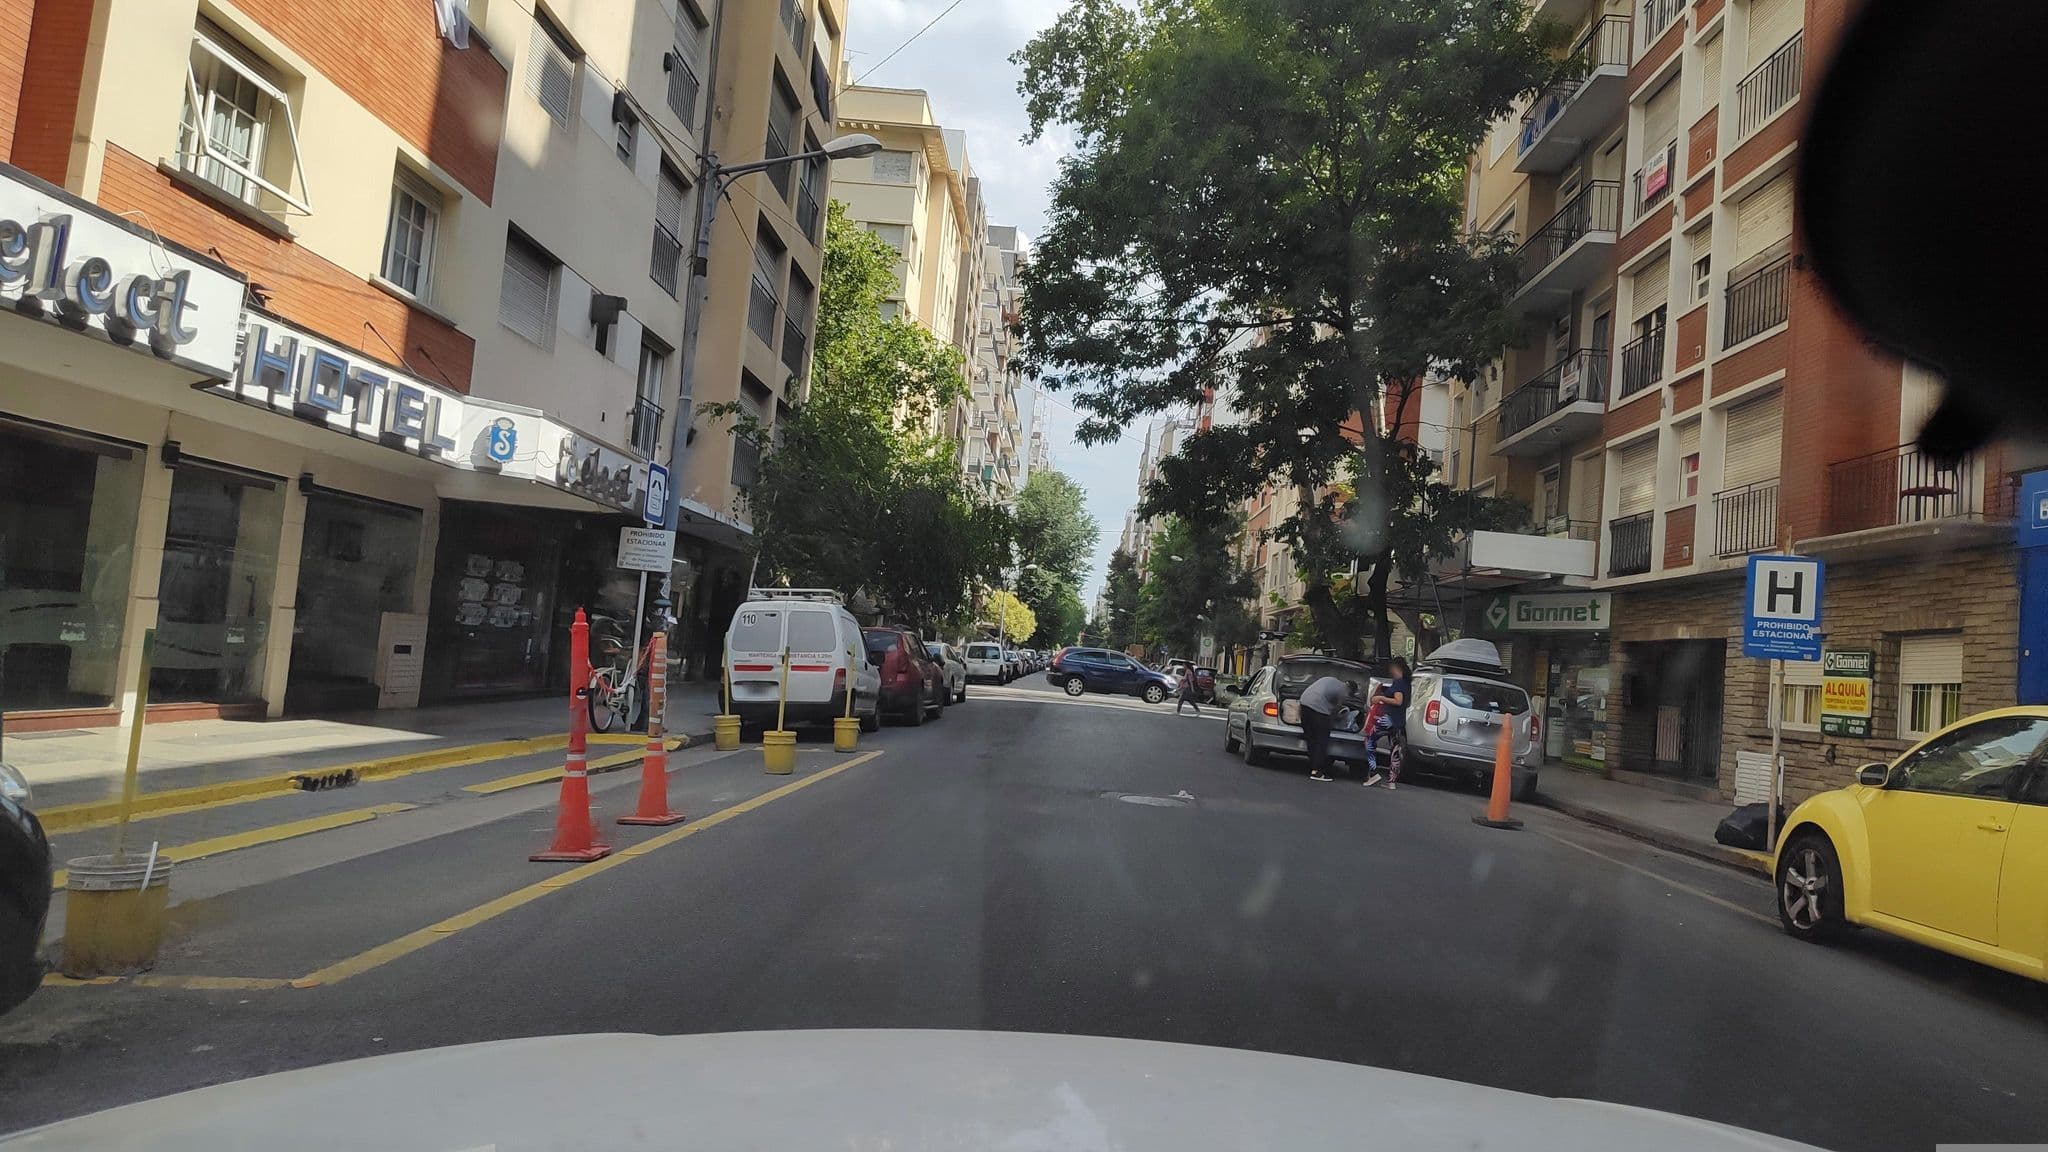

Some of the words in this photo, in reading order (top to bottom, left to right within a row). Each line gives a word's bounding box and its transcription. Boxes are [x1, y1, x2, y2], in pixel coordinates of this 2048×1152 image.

[244, 324, 456, 451] HOTEL
[494, 430, 511, 456] S
[630, 530, 665, 539] PROHIBIDO
[626, 538, 667, 547] ESTACIONAR
[1767, 570, 1803, 614] H
[1517, 599, 1601, 622] Gonnet
[742, 614, 757, 625] 110
[1756, 621, 1810, 631] PROHIBIDO
[1752, 630, 1814, 641] ESTACIONAR
[1836, 654, 1868, 669] Gonnet
[1825, 682, 1866, 698] ALQUILA
